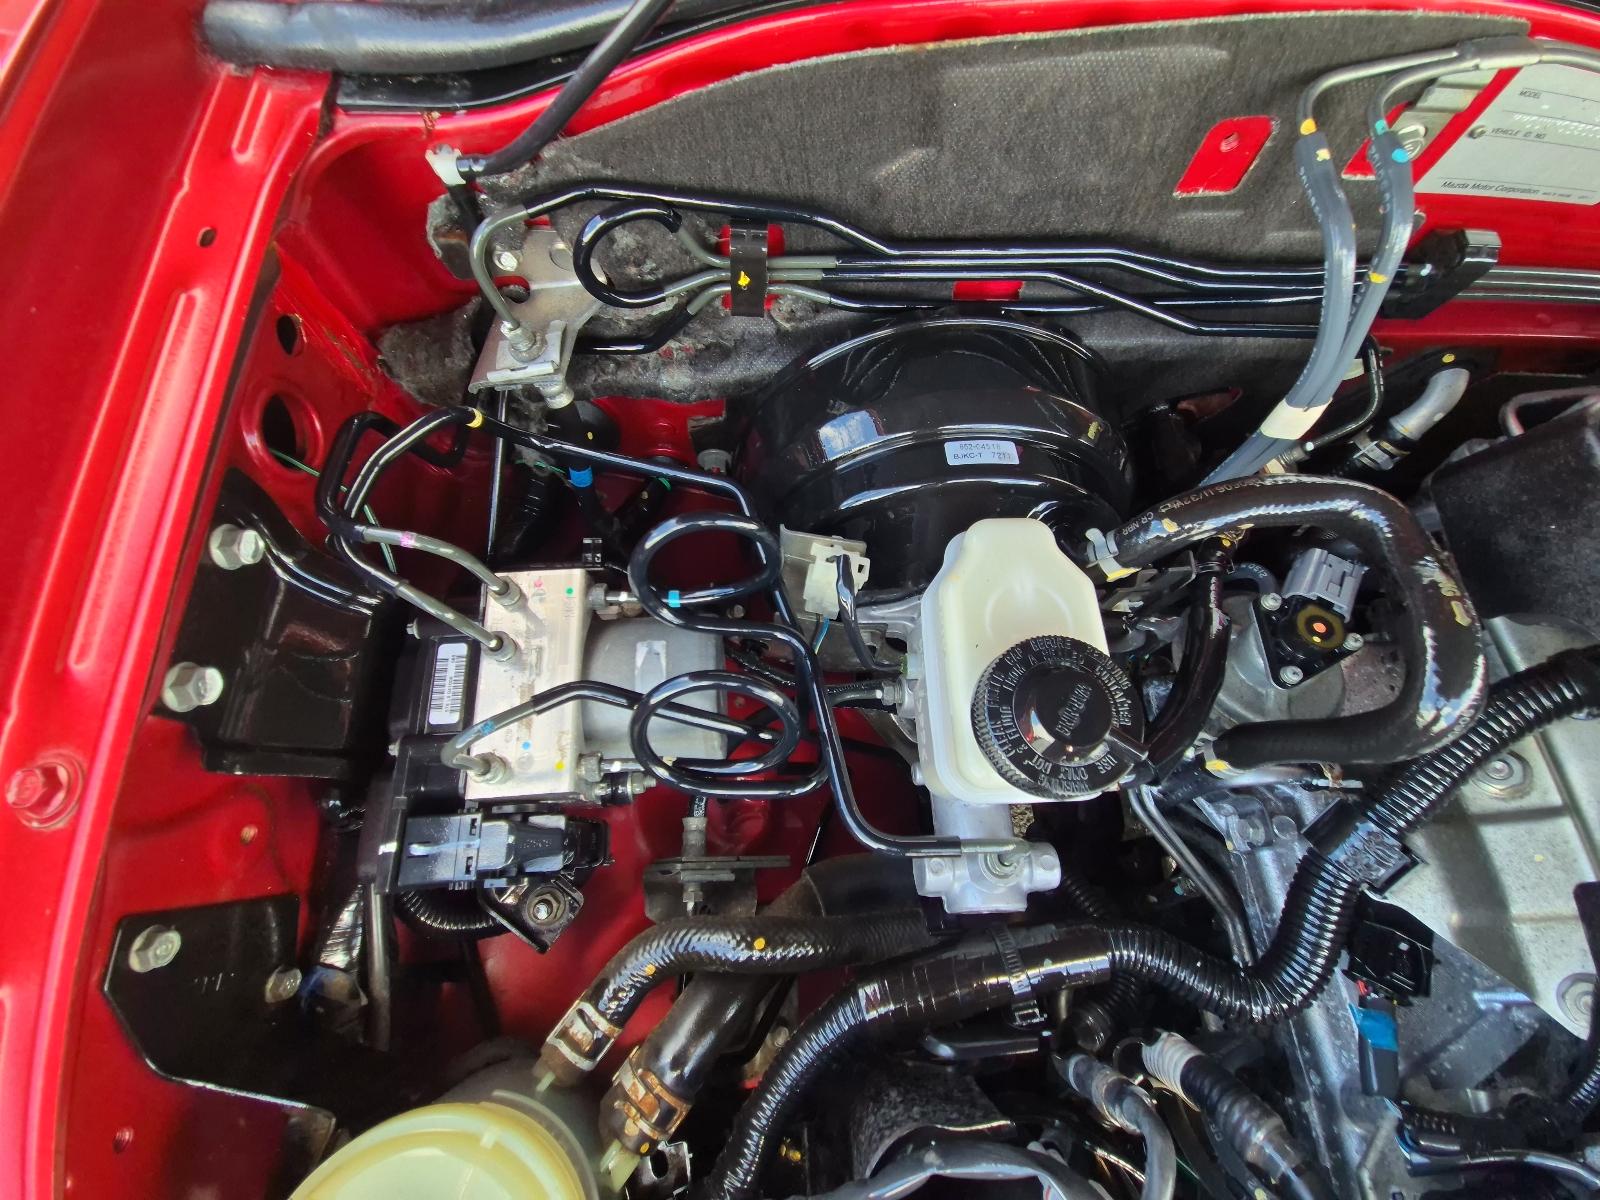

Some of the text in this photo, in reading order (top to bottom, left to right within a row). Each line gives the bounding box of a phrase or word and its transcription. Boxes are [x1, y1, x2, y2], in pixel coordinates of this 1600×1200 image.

[1519, 90, 1541, 99] MODEL
[1490, 128, 1520, 136] VEHICLE
[1441, 181, 1469, 189] Mazda
[1470, 183, 1494, 192] Motor
[1494, 184, 1541, 195] Corporation
[1095, 753, 1117, 775] USE
